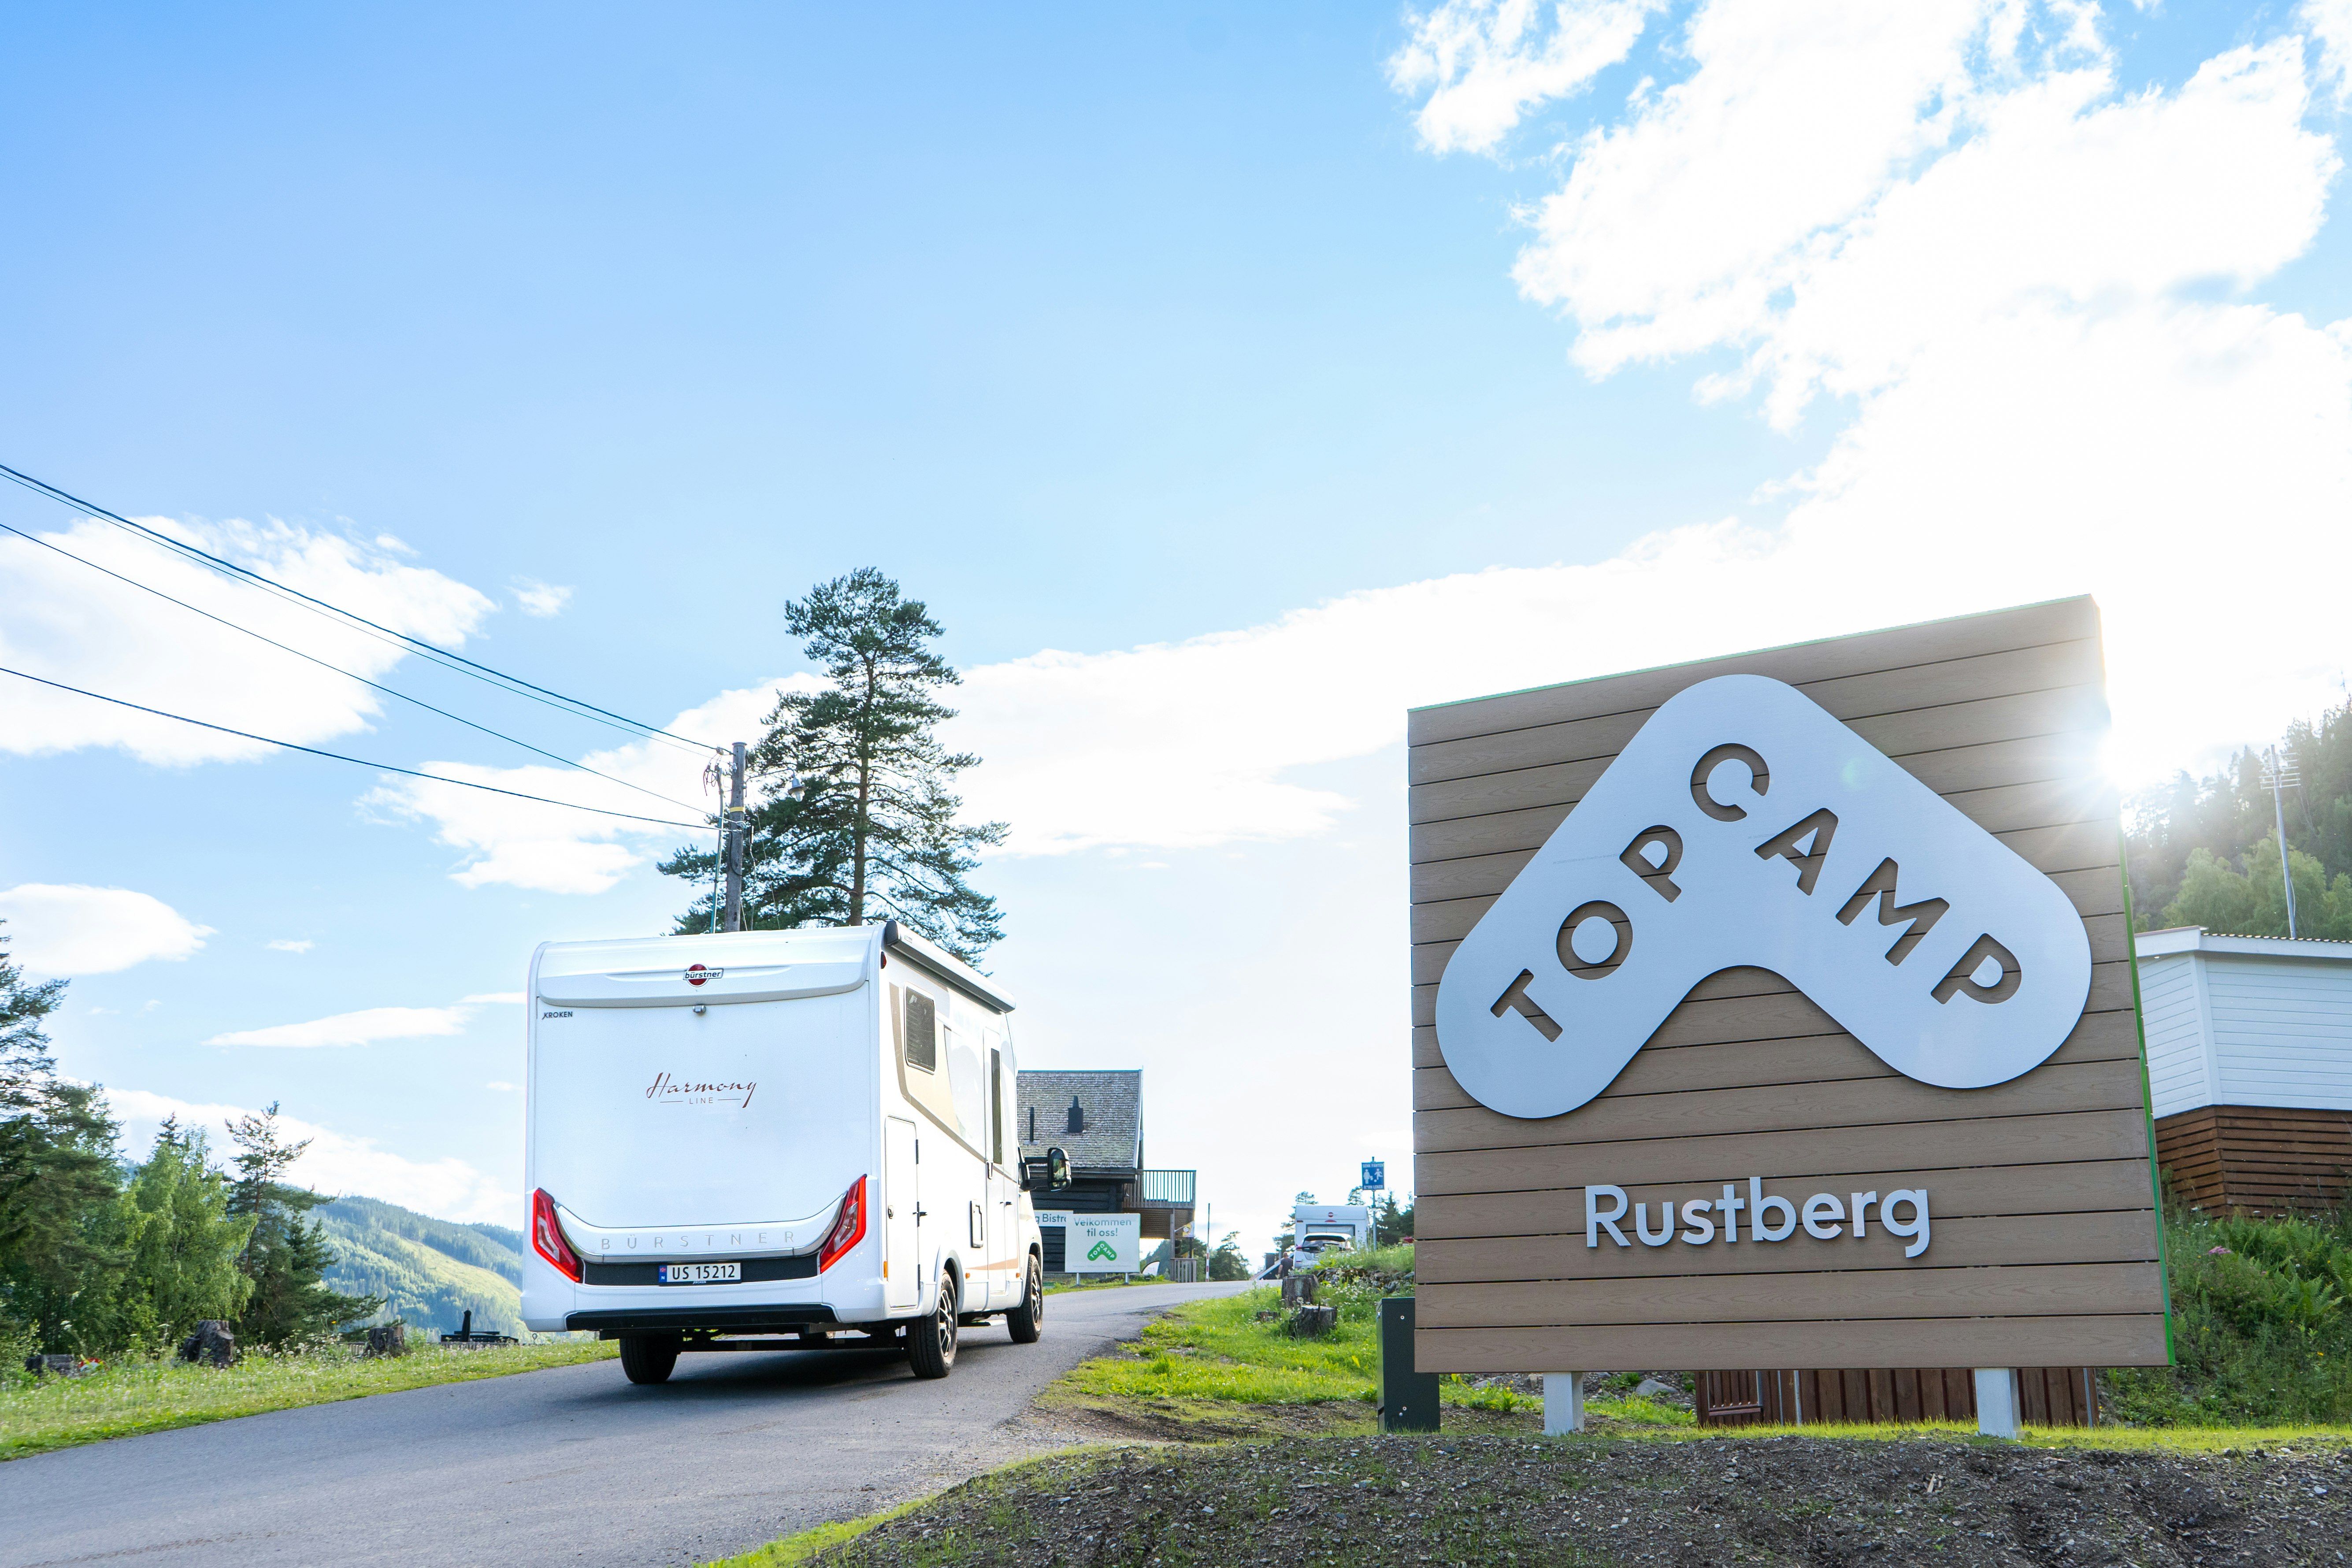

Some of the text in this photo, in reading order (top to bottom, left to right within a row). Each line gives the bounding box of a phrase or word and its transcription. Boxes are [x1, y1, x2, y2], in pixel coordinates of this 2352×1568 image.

[1490, 743, 2022, 1042] TOPCAMP
[542, 1011, 573, 1020] KROKEN
[646, 1072, 757, 1108] Harmony
[1074, 1217, 1131, 1226] Velkommen
[1585, 1176, 1931, 1258] Rustberg
[601, 1231, 794, 1250] BÜRSTNER
[1087, 1227, 1118, 1237] til oss!
[672, 1264, 735, 1280] US 15212
